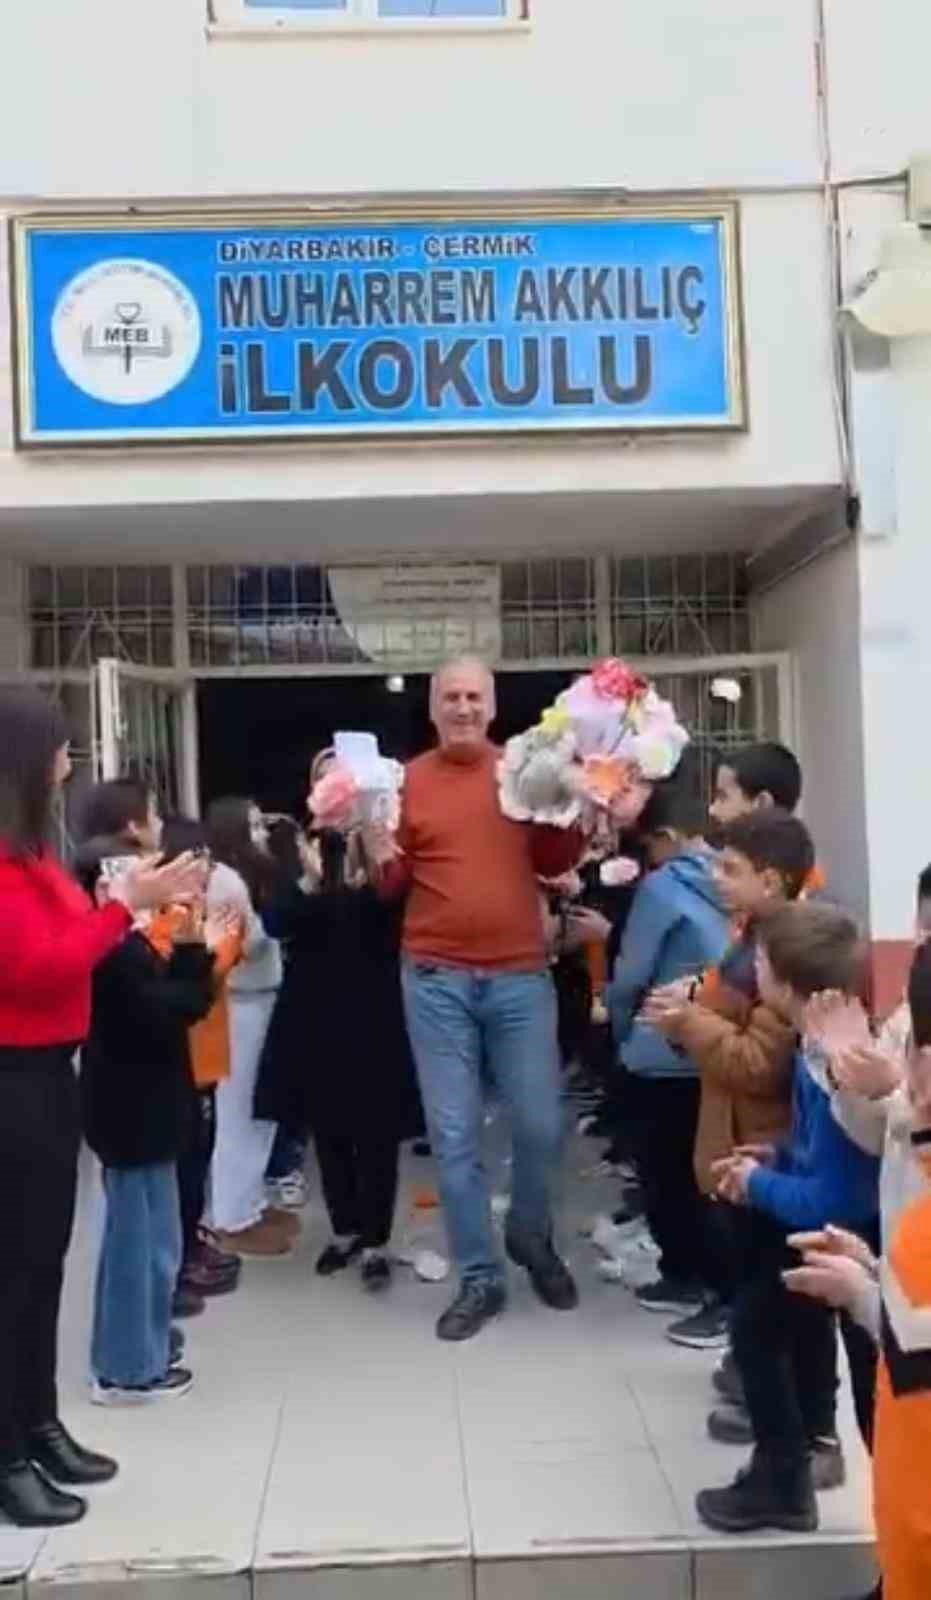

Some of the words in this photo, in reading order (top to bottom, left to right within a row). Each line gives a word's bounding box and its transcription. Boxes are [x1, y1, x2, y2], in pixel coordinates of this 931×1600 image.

[218, 268, 496, 329] MUHARREM
[514, 264, 706, 335] AKKILIÇ
[103, 327, 150, 343] MEB
